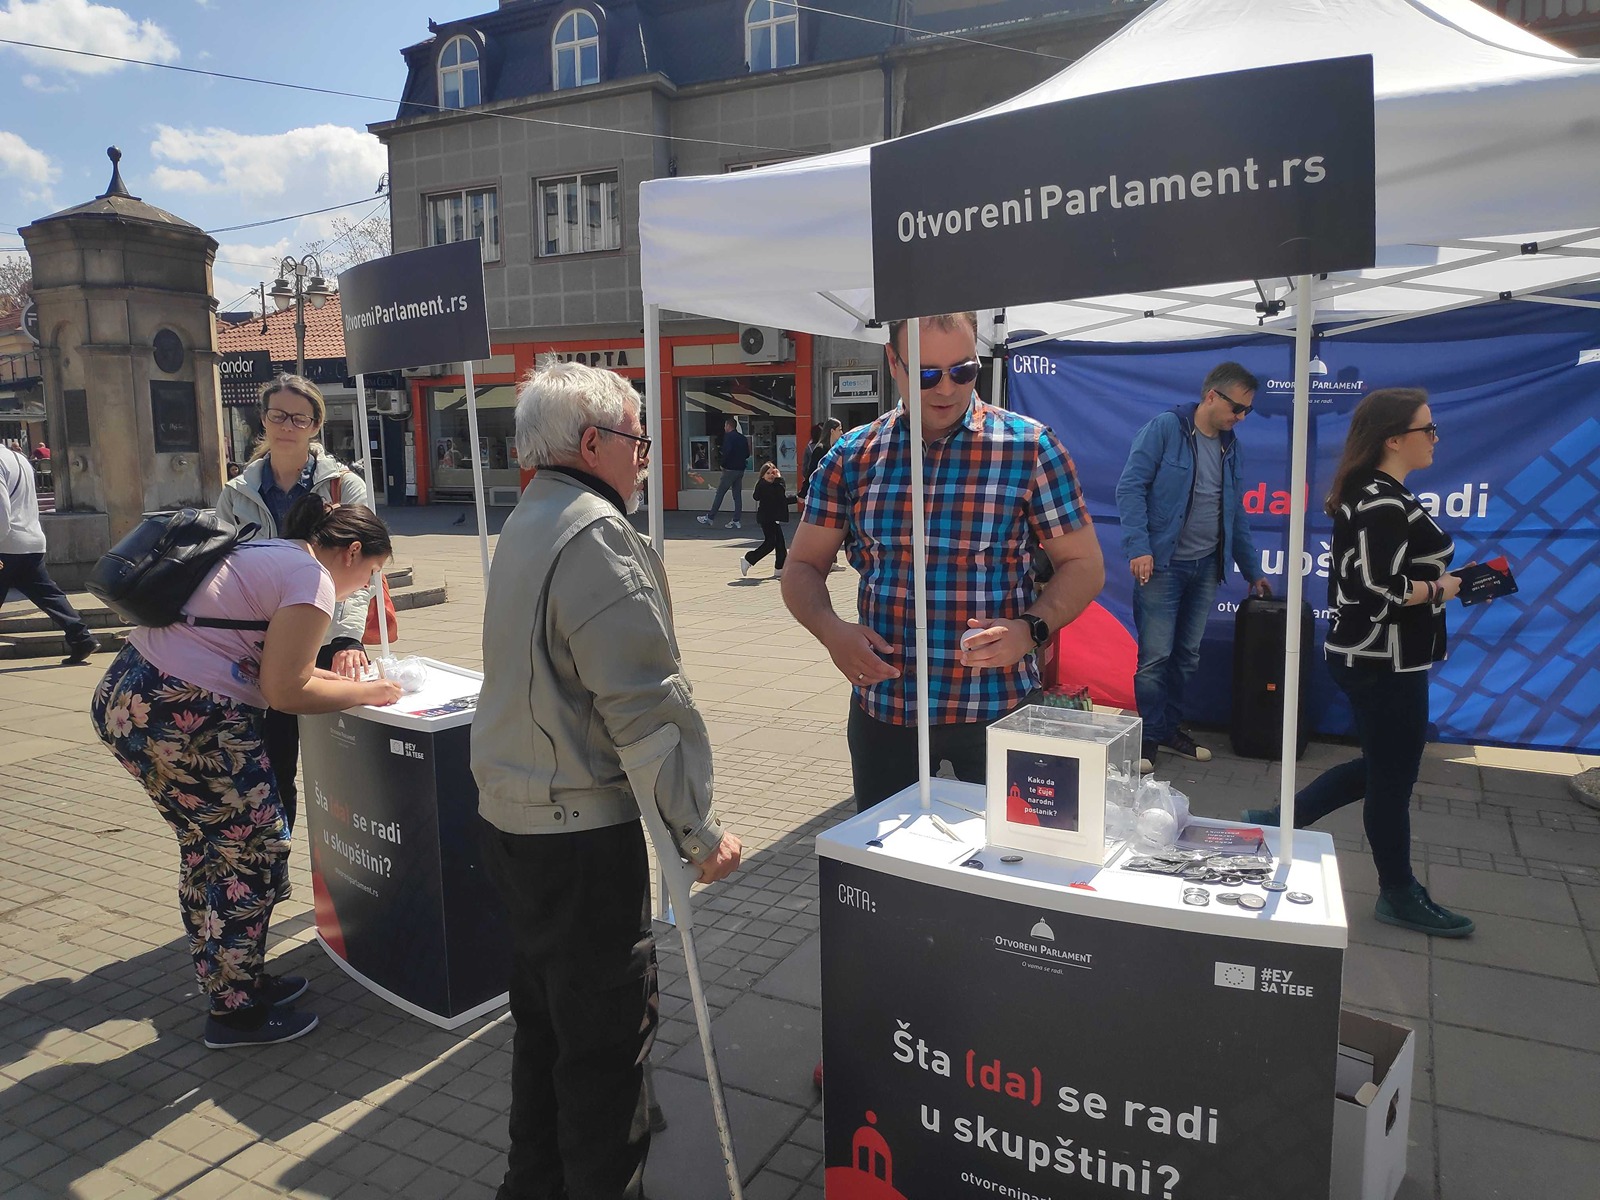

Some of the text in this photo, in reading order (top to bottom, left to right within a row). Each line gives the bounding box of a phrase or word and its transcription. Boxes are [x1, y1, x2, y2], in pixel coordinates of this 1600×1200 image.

[897, 155, 1327, 243] OtvoreniParlament.rs
[1013, 354, 1057, 375] CRTA:
[1417, 483, 1489, 518] adi
[1028, 776, 1045, 785] Kako
[1024, 807, 1058, 817] poslanik?
[1028, 797, 1054, 806] narodni
[352, 811, 368, 833] se
[370, 819, 402, 845] radi
[322, 829, 393, 879] u skupštini?
[838, 883, 877, 913] CRTA:
[1260, 981, 1314, 997] ЗА ТЕБЕ
[892, 1018, 1218, 1145] Šta (da) se radi
[920, 1104, 1181, 1200] u skupštini?
